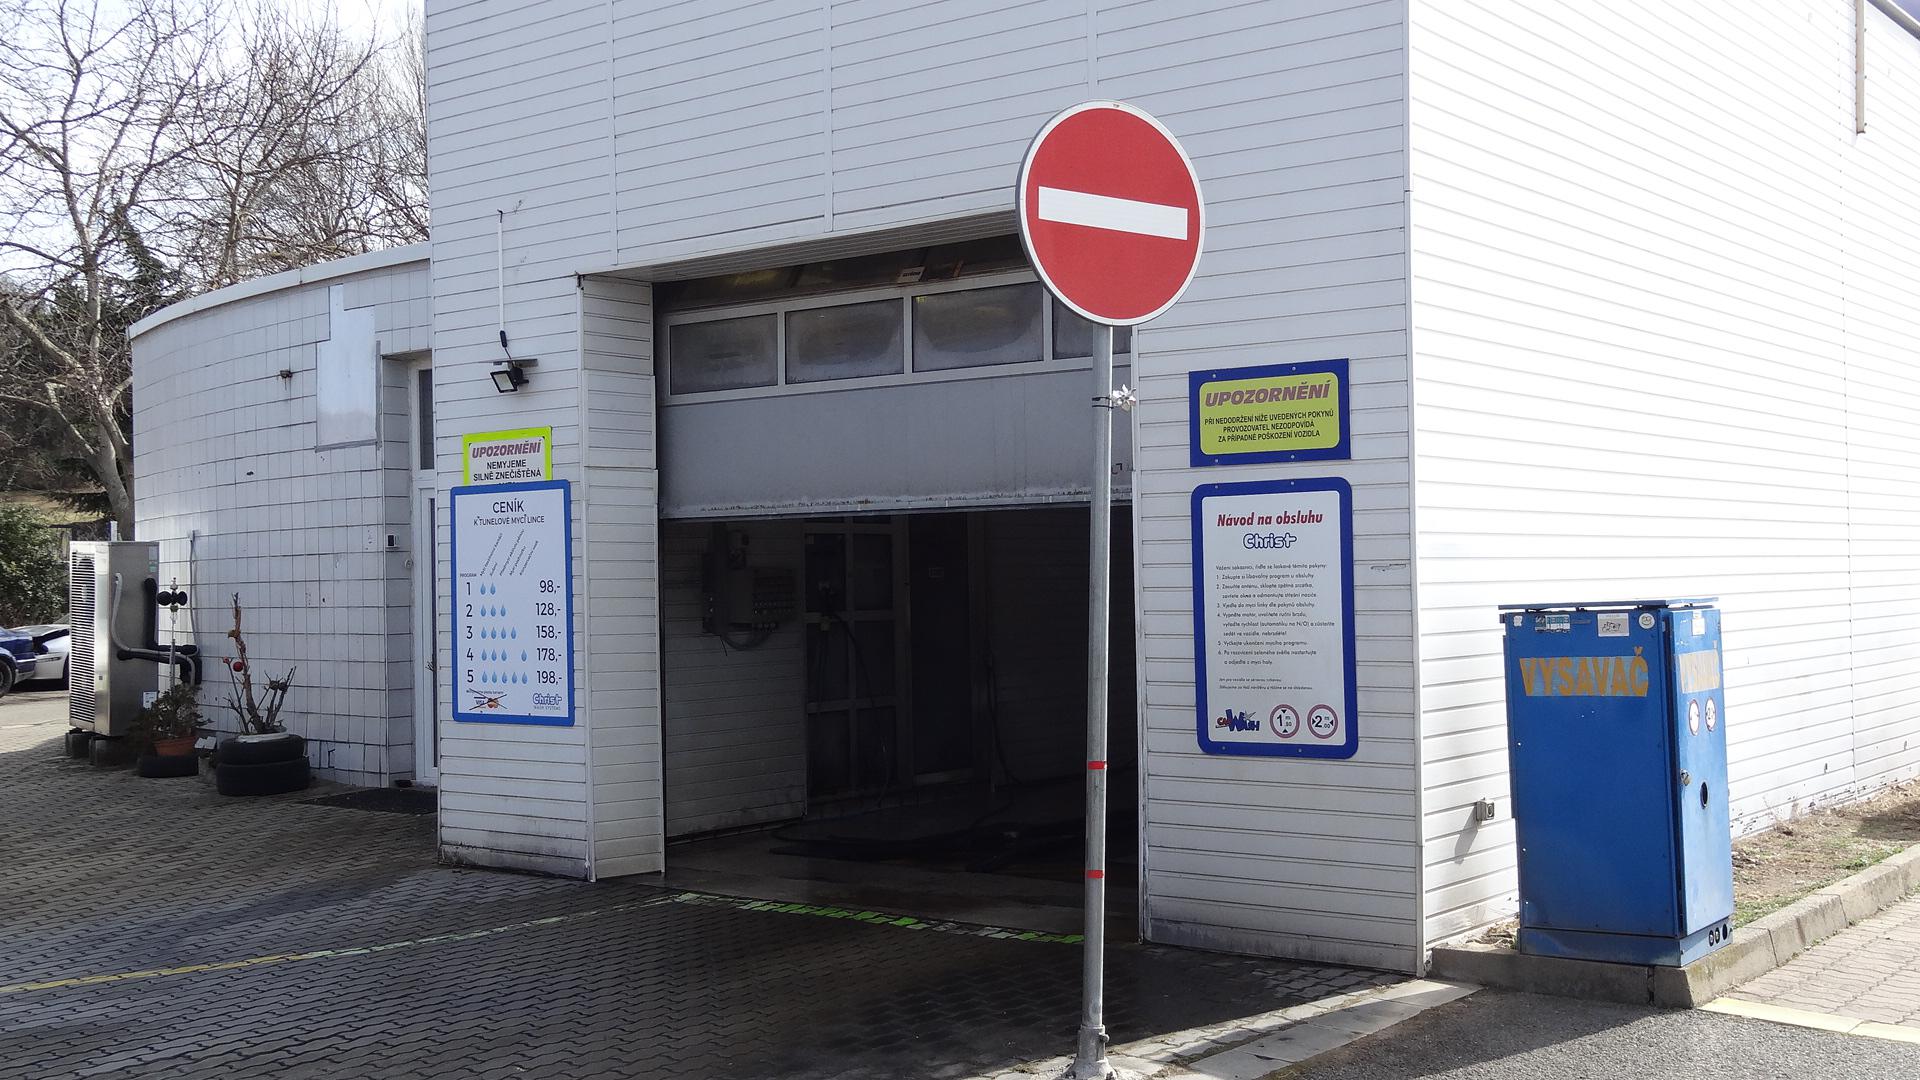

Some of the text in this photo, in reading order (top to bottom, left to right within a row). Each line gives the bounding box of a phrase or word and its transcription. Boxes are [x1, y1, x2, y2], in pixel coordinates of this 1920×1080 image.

[1205, 380, 1331, 407] UPOZORNĚNÍ
[1204, 417, 1214, 425] PŘI
[1216, 414, 1254, 424] NEDODRŽENÍ
[1308, 408, 1334, 418] POKYNŮ
[1223, 424, 1270, 432] PROVOZOVATEL
[1258, 430, 1292, 440] POŠKOZENÍ
[472, 439, 542, 458] UPOZORNĚNÍ
[486, 459, 526, 470] NEMYJEME
[474, 468, 542, 482] SILNĚ ZNEČIŠTĚNÁ
[492, 498, 524, 514] CENÍK
[527, 516, 544, 524] LINCE
[1217, 510, 1323, 526] Návod na obsluhu
[1243, 532, 1297, 549] Christ
[466, 580, 560, 596] 1 98,-
[466, 602, 560, 618] 2 128,-
[466, 626, 561, 640] 3 158,-
[466, 648, 562, 662] 4 178,-
[467, 670, 562, 685] 5 198,-
[1520, 646, 1648, 697] VYSAVAČ
[533, 692, 562, 705] Christ
[1276, 714, 1282, 726] 1
[1314, 715, 1323, 728] 2
